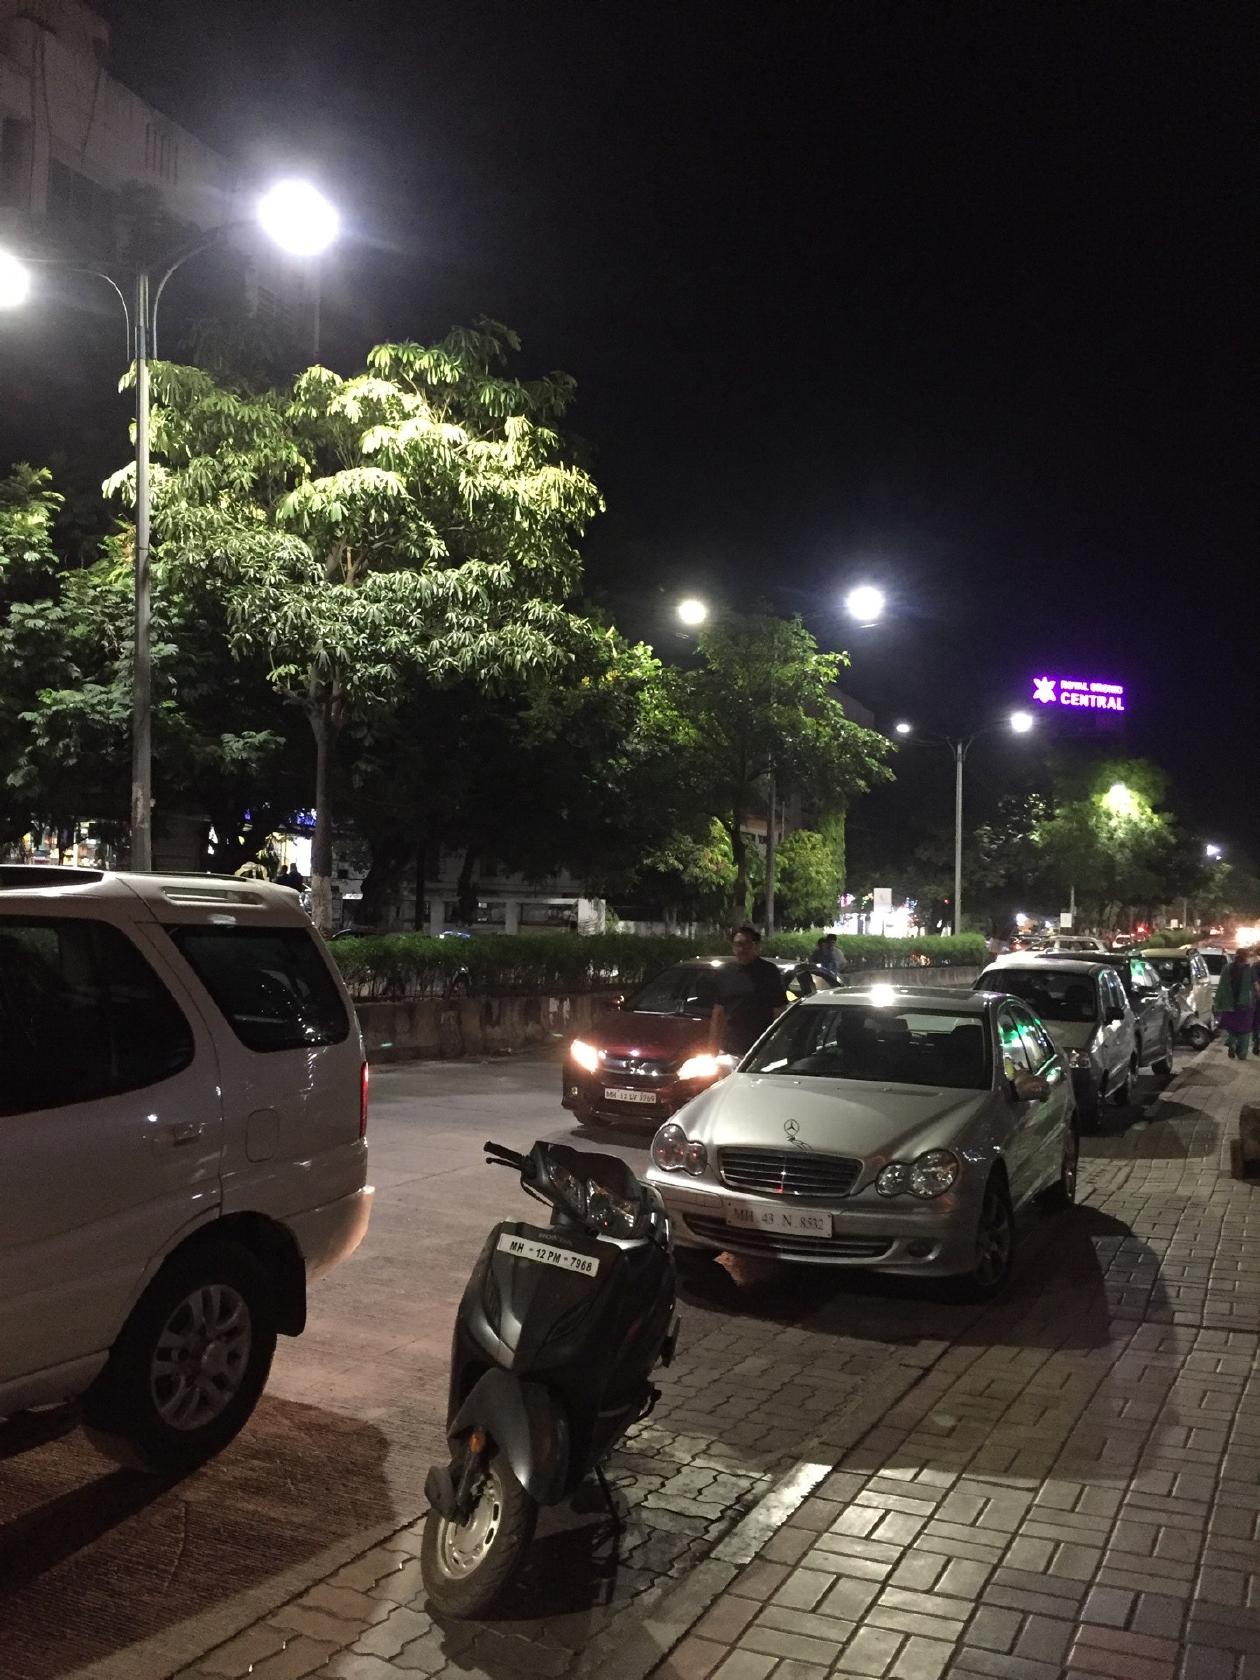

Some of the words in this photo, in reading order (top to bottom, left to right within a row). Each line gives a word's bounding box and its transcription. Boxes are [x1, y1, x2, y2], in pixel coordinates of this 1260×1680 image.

[1061, 692, 1125, 711] CENTRAL
[734, 1207, 754, 1222] MH
[761, 1213, 774, 1225] 43
[782, 1214, 793, 1227] N
[509, 1241, 525, 1253] MH
[536, 1248, 546, 1259] 12
[547, 1251, 562, 1264] PM
[570, 1257, 593, 1272] 7968
